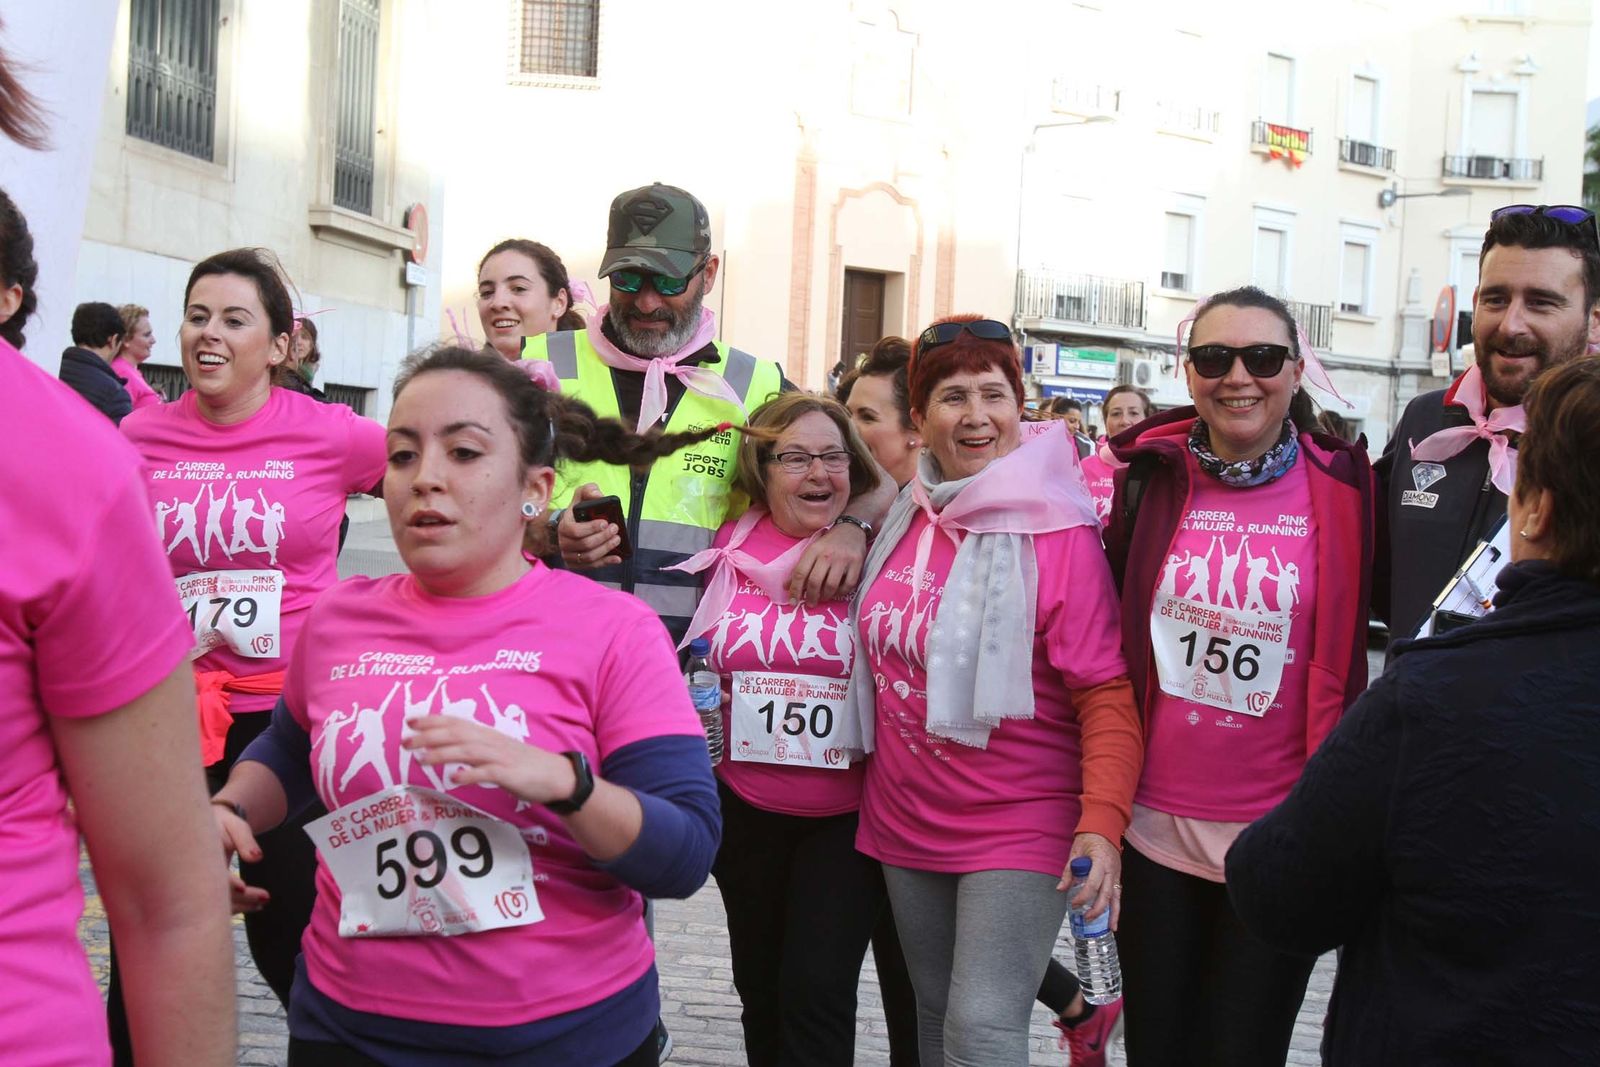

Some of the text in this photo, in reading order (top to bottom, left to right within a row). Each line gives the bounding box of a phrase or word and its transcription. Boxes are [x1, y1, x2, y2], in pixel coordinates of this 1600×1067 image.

[175, 460, 294, 472] CARRERA PINK
[684, 453, 727, 468] SPORT
[152, 470, 295, 480] DE LA MUJER & RUNNING
[682, 463, 725, 478] JOBS
[1278, 514, 1308, 526] PINK
[1192, 521, 1234, 532] MUJER
[1247, 524, 1308, 536] RUNNING
[180, 576, 218, 590] CARRERA
[252, 576, 275, 584] PINK
[189, 584, 218, 597] MUJER
[228, 584, 276, 592] RUNNING
[186, 597, 258, 631] 179
[1179, 602, 1222, 622] CARRERA
[1257, 621, 1284, 634] PINK
[1160, 606, 1172, 618] DE
[1174, 610, 1185, 622] LA
[1188, 614, 1220, 632] MUJER
[1231, 625, 1282, 643] RUNNING
[358, 649, 542, 666] CARRERA PINK
[1179, 630, 1261, 682] 156
[330, 664, 348, 681] DE
[348, 664, 366, 678] LA
[368, 662, 432, 676] MUJER
[448, 662, 540, 674] RUNNING
[739, 685, 750, 694] DE
[752, 686, 762, 694] LA
[764, 686, 796, 696] MUJER
[756, 677, 796, 688] CARRERA
[758, 700, 833, 738] 150
[350, 792, 413, 824] CARRERA
[328, 832, 350, 850] DE
[353, 825, 371, 841] LA
[374, 808, 417, 834] MUJER
[376, 826, 494, 900] 599
